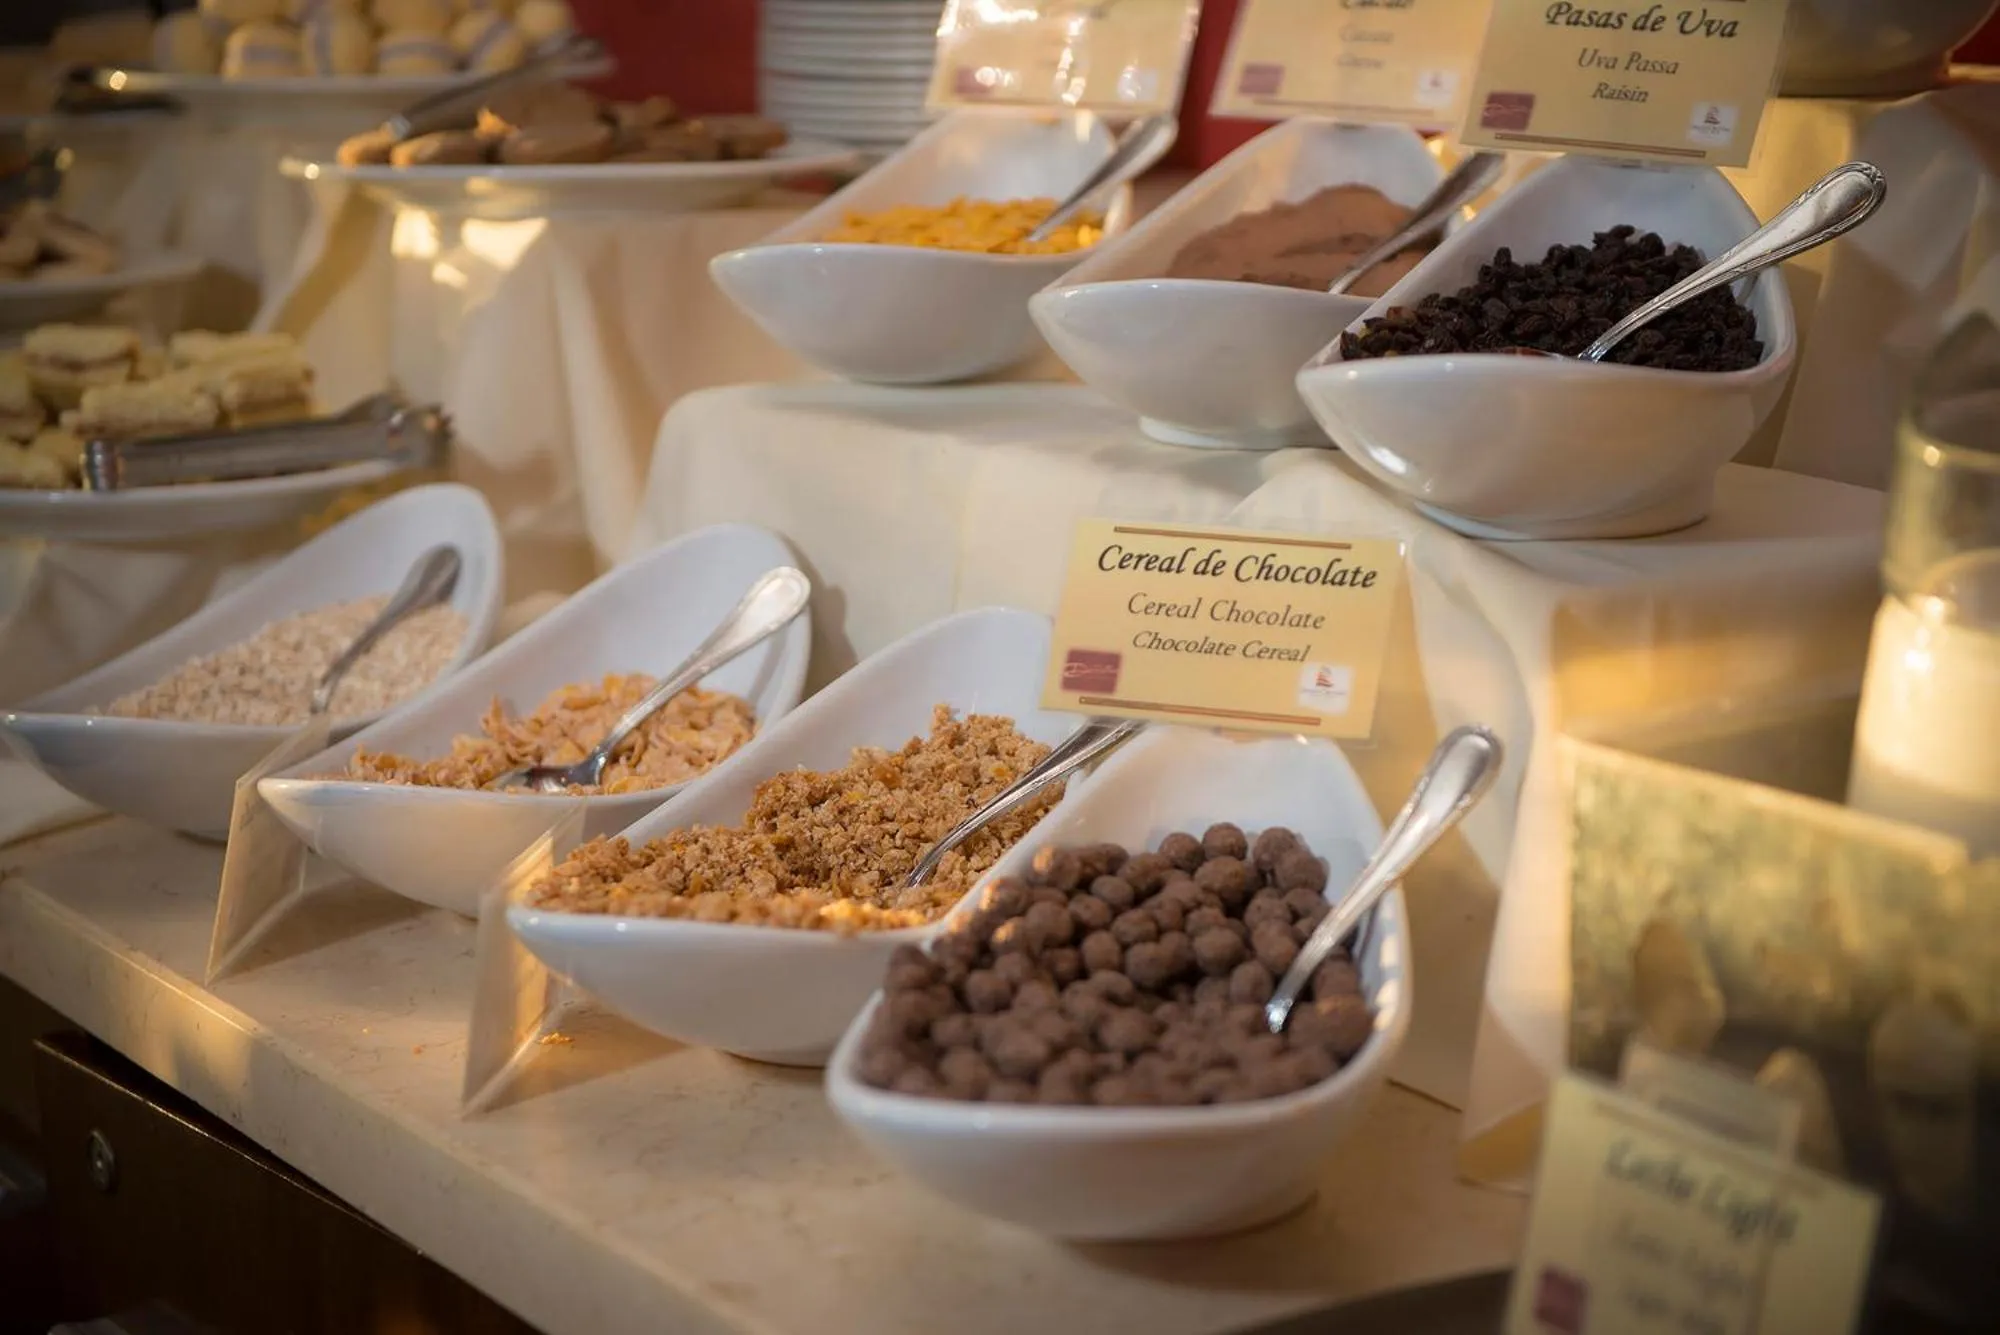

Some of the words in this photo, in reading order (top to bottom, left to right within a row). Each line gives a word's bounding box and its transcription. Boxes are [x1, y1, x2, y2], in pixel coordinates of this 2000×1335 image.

[1546, 2, 1629, 31] Pasas
[1633, 5, 1667, 33] de
[1677, 9, 1739, 39] Uva
[1578, 48, 1618, 71] Uva
[1624, 51, 1680, 75] Passa
[1098, 544, 1193, 575] Cereal
[1193, 549, 1227, 578] de
[1234, 553, 1378, 589] Chocolate
[1128, 592, 1202, 620] Cereal
[1210, 600, 1326, 630] Chocolate
[1133, 631, 1237, 656] Chocolate
[1242, 640, 1311, 663] Cereal
